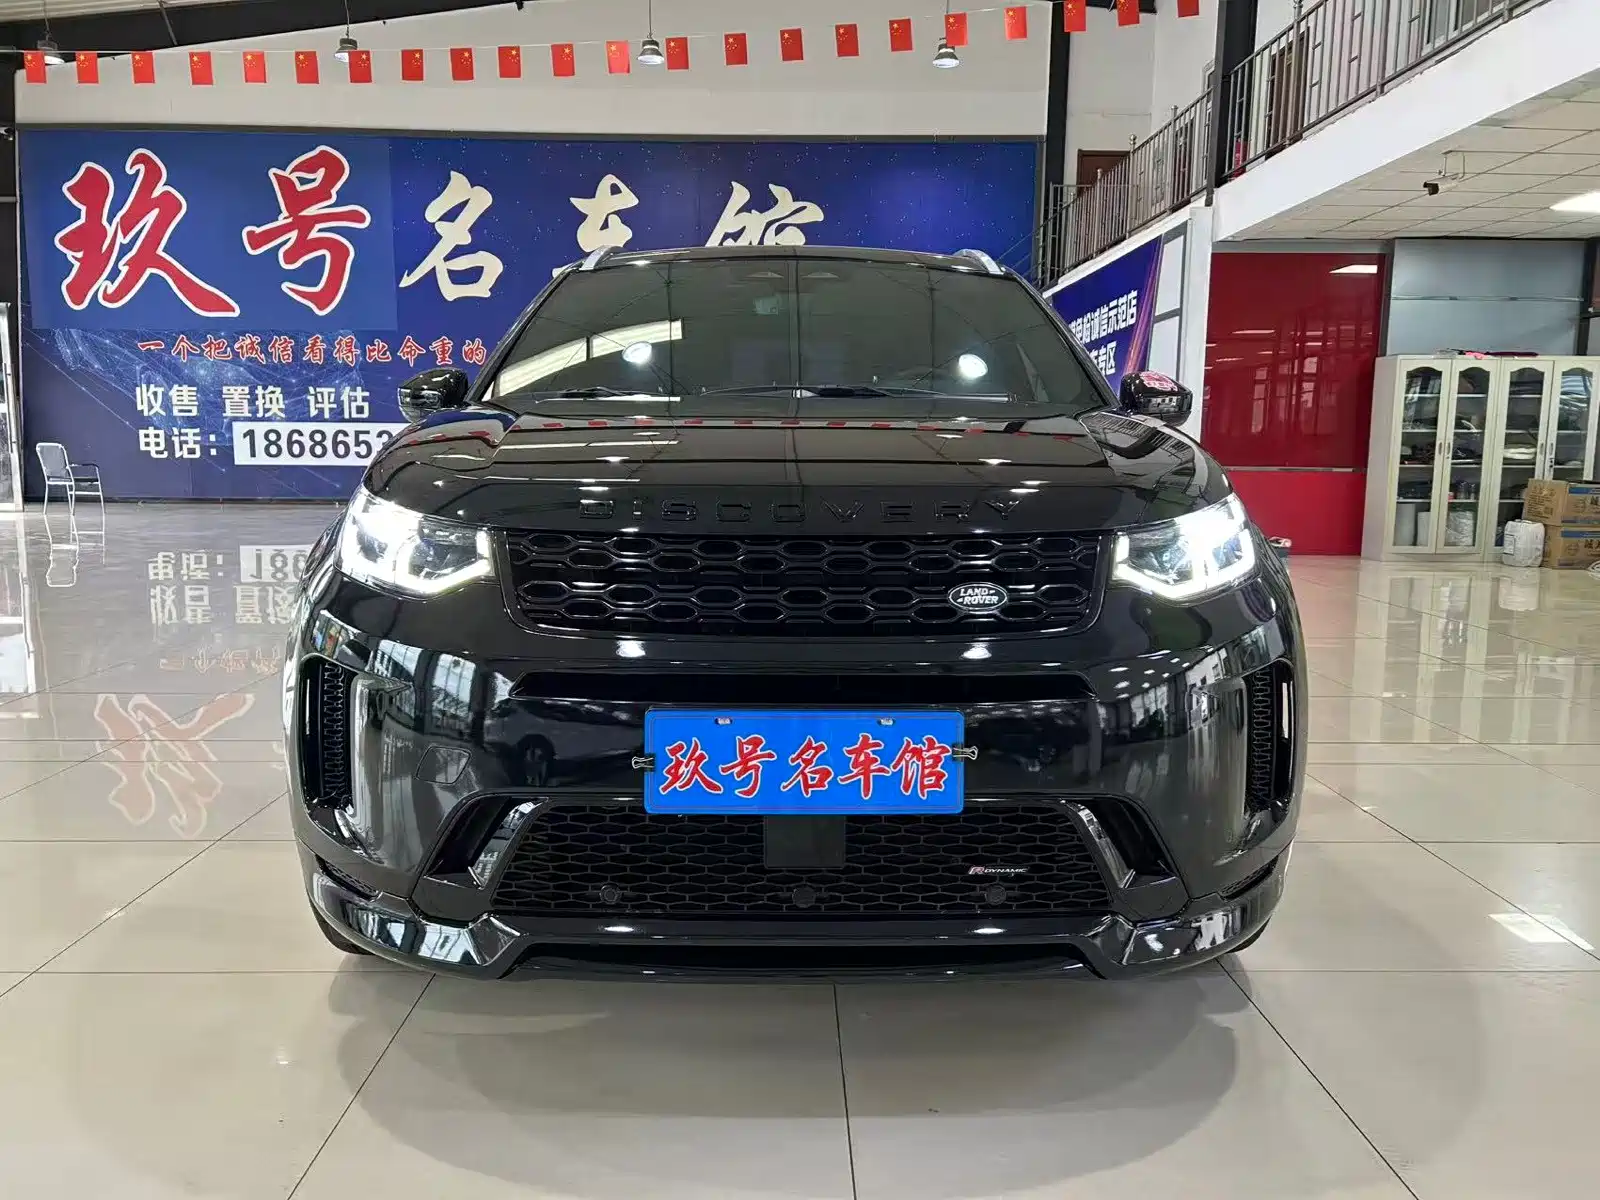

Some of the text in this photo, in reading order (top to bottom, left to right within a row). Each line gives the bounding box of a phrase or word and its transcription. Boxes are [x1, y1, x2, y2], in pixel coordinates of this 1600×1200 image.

[135, 384, 370, 419] 收售 置换 评估
[138, 427, 217, 459] 电话：
[579, 499, 1023, 523] DISCOVERY
[960, 588, 989, 597] LAND
[963, 595, 999, 605] ROVER
[660, 733, 952, 799] 玖号名车馆
